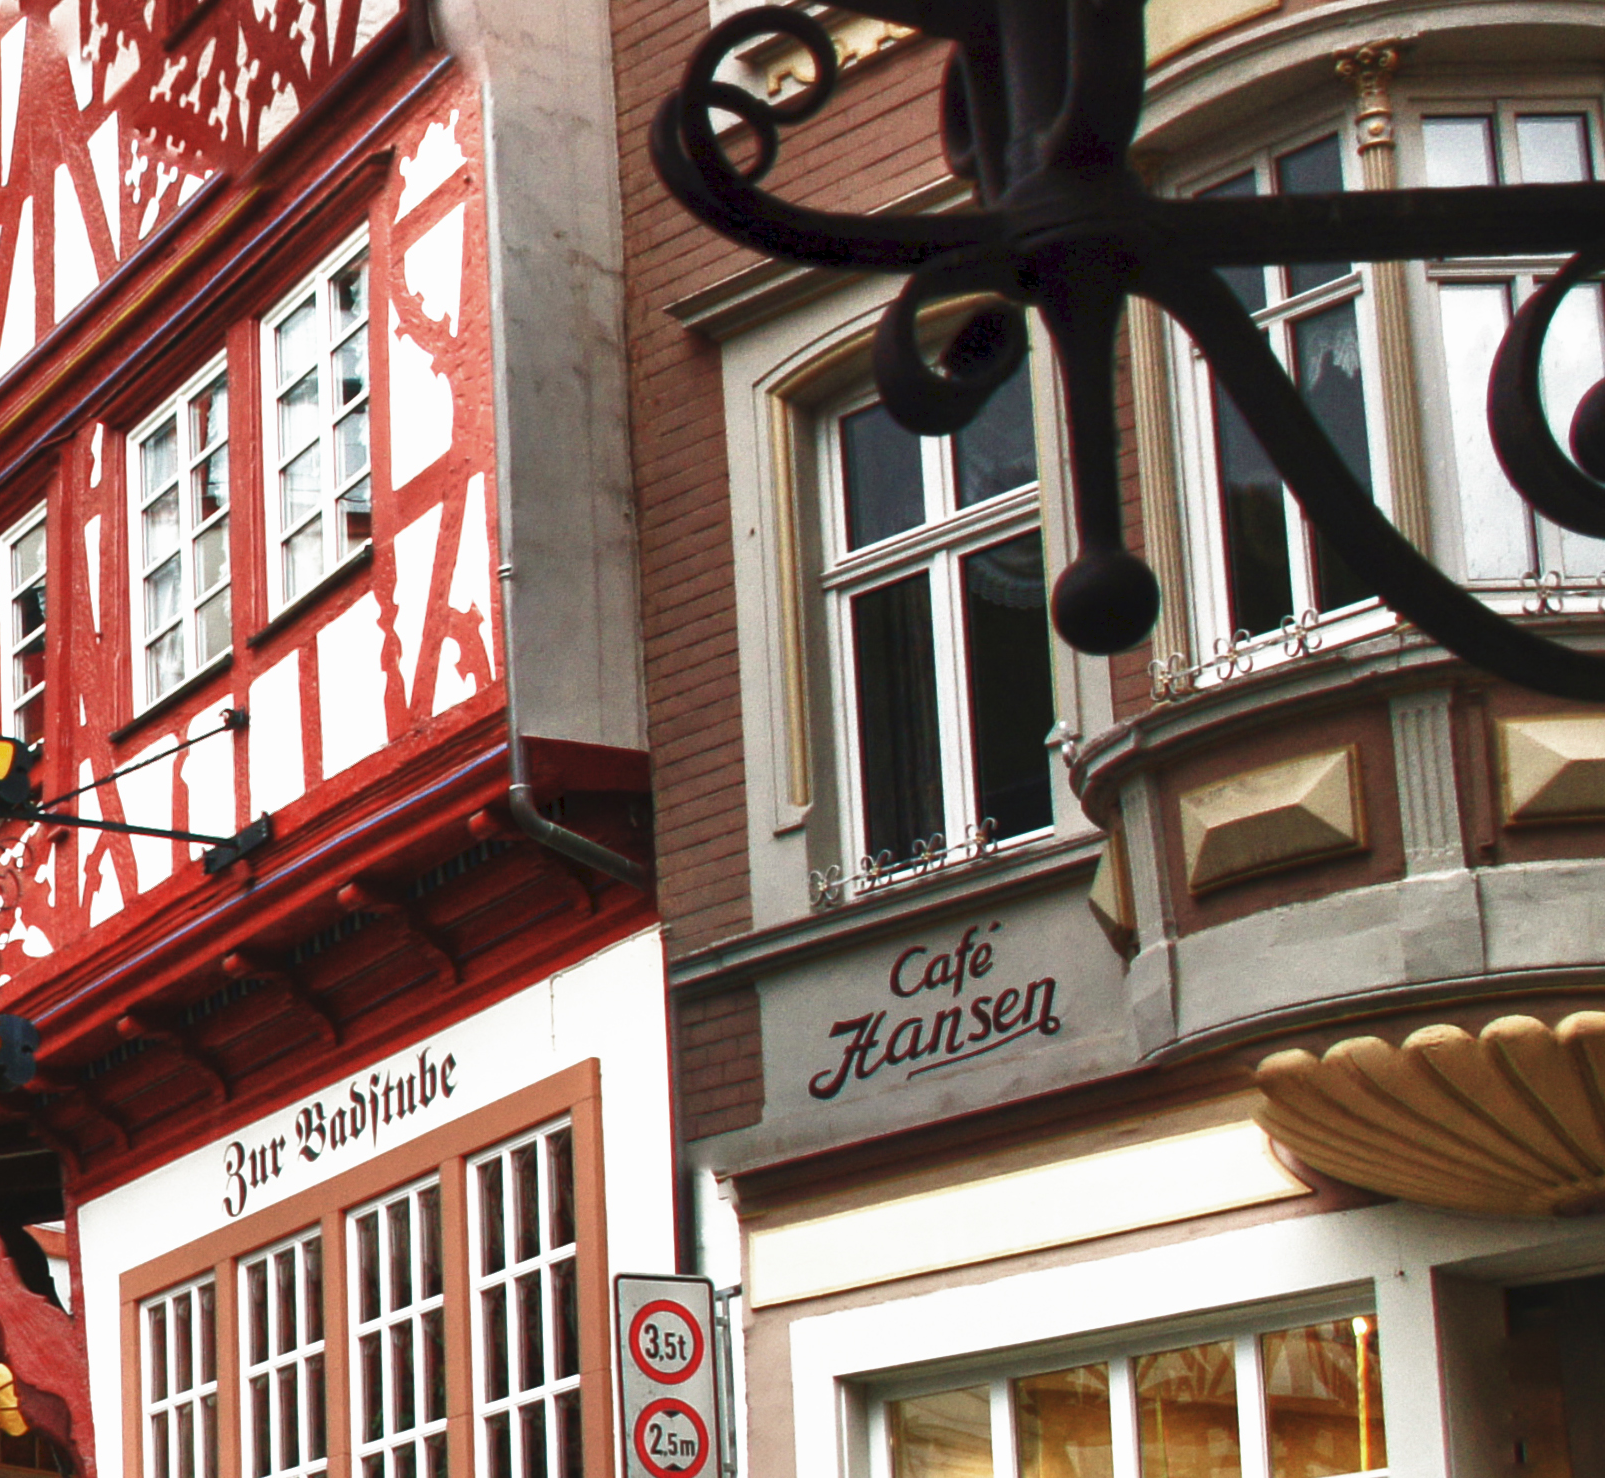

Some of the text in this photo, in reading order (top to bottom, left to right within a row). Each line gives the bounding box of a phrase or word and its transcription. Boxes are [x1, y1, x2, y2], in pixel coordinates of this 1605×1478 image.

[890, 921, 1001, 998] Café
[808, 977, 1061, 1099] Hansen
[222, 1134, 286, 1217] Zur
